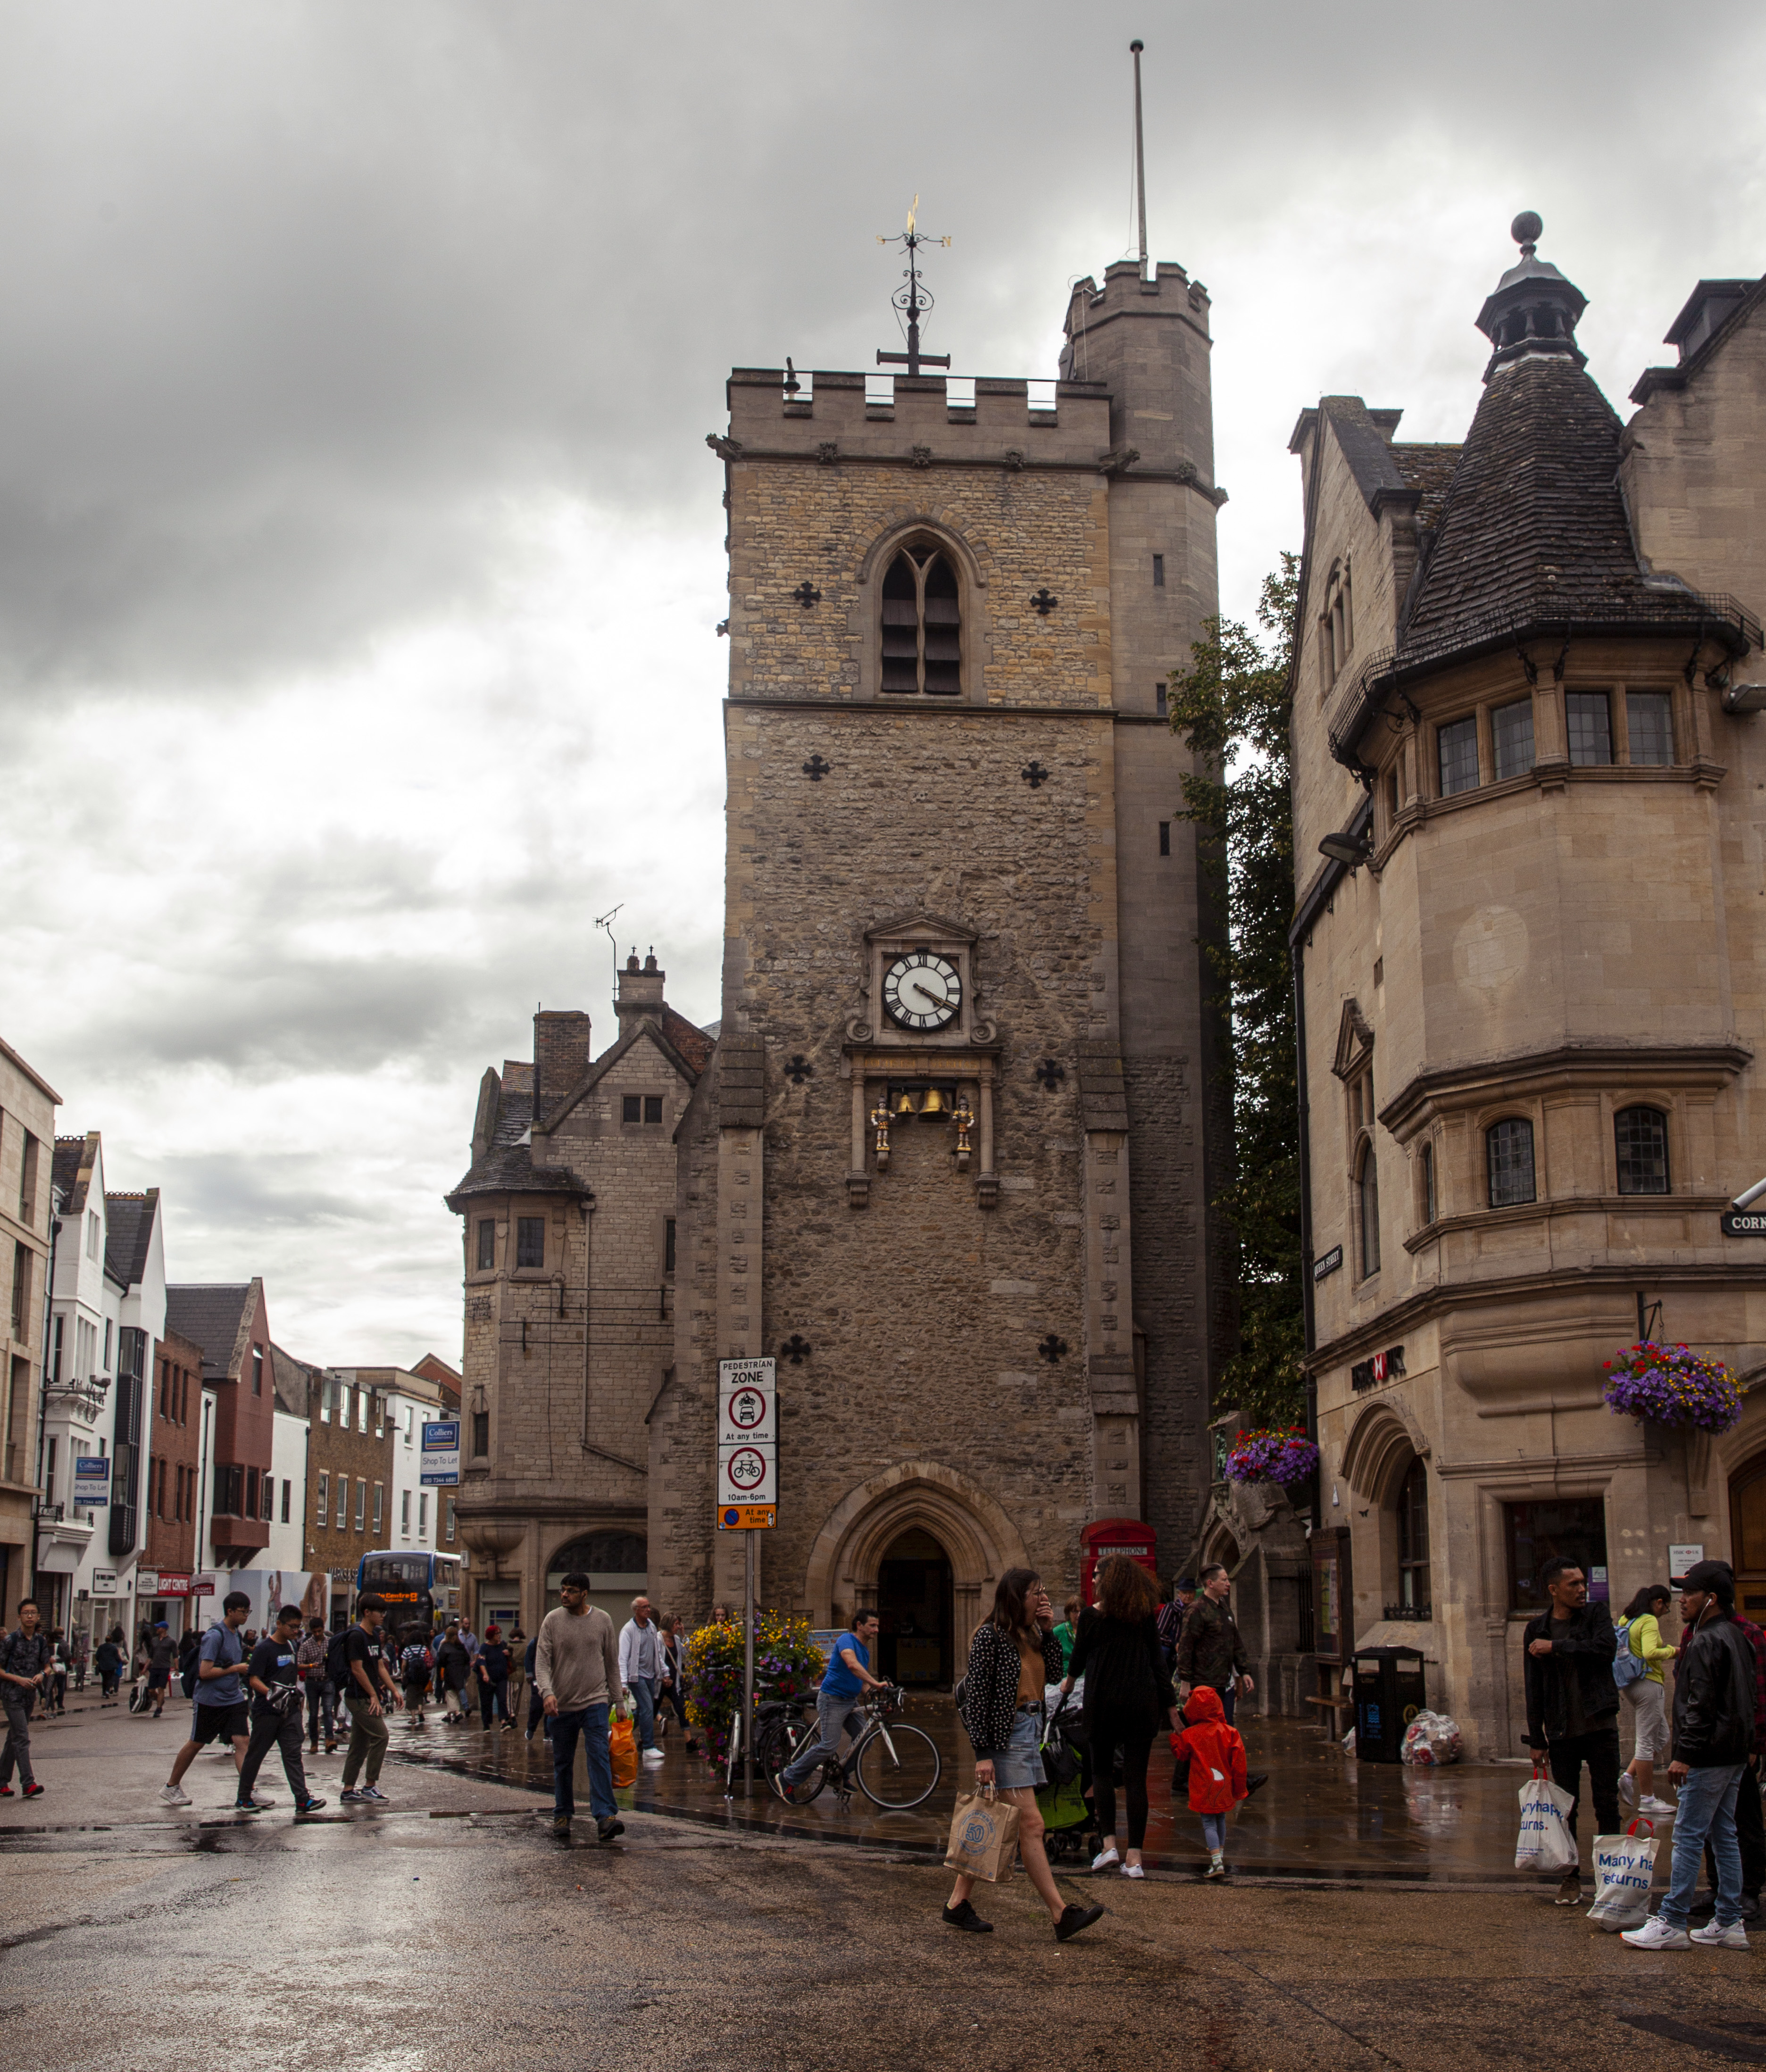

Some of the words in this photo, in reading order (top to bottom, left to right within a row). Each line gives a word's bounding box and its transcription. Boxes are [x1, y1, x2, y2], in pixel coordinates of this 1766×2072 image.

[1315, 1260, 1325, 1277] QUEEN
[1326, 1250, 1339, 1268] STREET
[723, 1360, 772, 1370] PEDESTRIAN
[732, 1371, 764, 1383] ZONE
[429, 1428, 453, 1437] Colliers
[423, 1457, 438, 1466] Shop
[728, 1493, 766, 1501] 10am-6pm
[172, 1579, 188, 1591] CENTRE
[410, 1592, 417, 1602] 8
[966, 1823, 984, 1843] 50
[1599, 1854, 1635, 1870] Many
